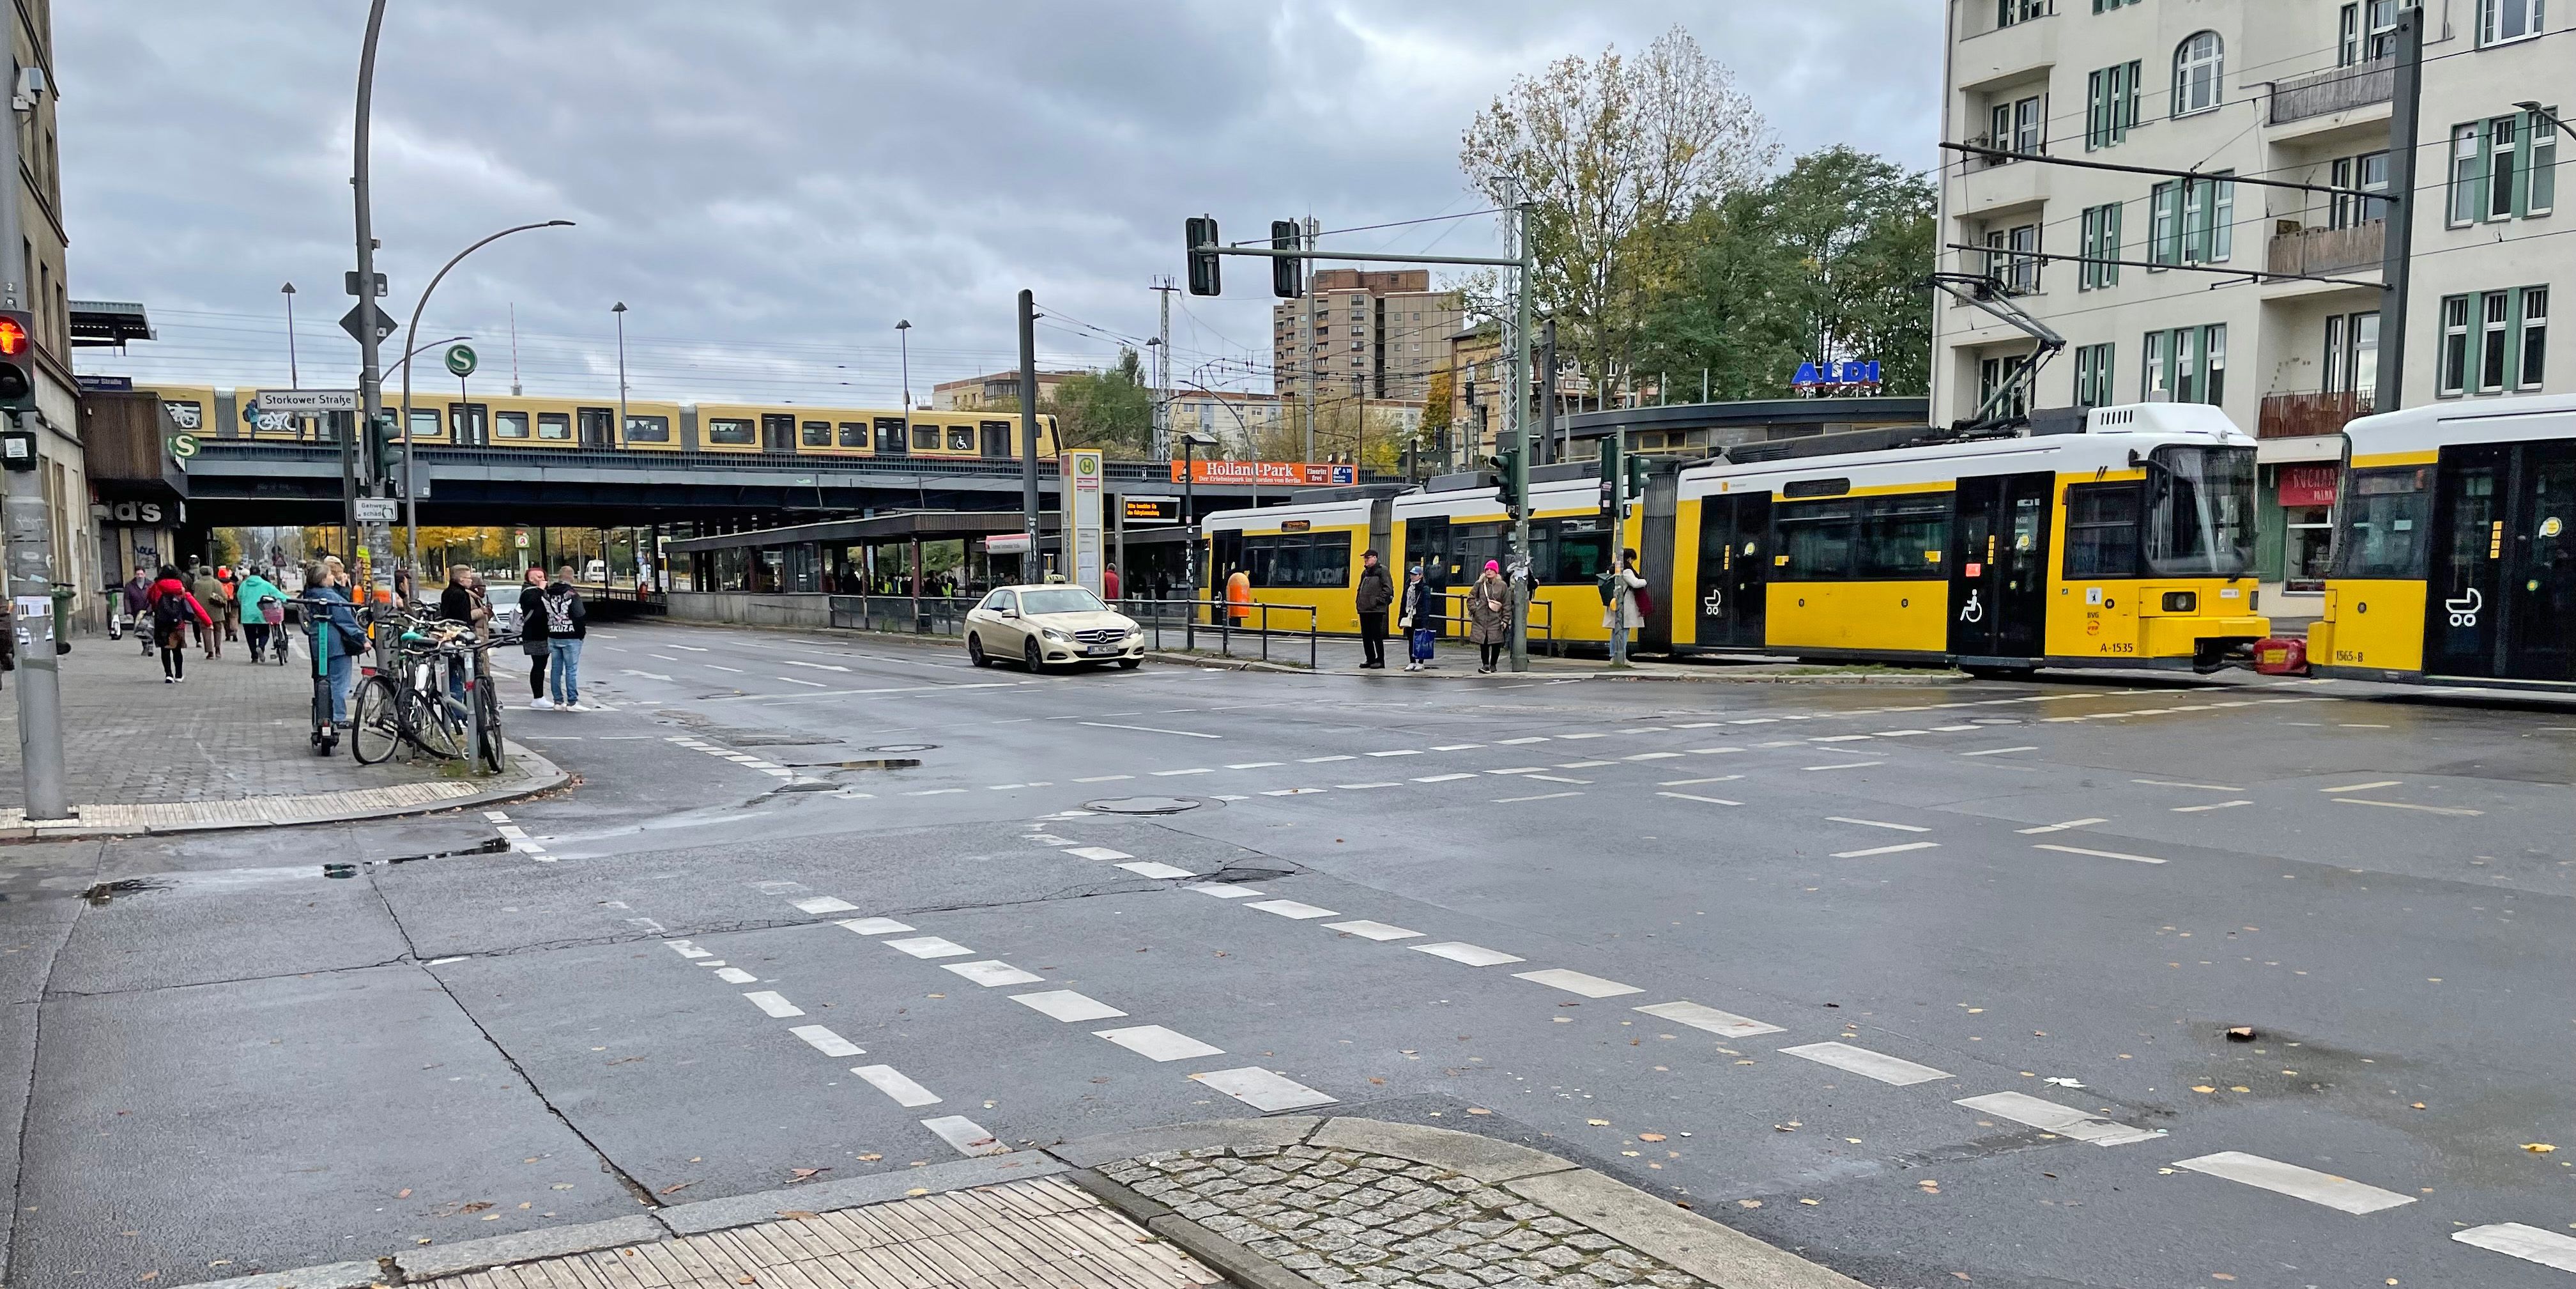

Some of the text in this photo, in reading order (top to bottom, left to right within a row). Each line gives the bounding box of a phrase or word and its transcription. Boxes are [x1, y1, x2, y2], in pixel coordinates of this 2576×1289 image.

[8, 283, 13, 291] 2
[452, 348, 470, 369] S
[1791, 360, 1880, 384] ALDI
[266, 394, 351, 406] Storkower Straße
[176, 435, 195, 456] S
[1084, 461, 1091, 471] H
[1206, 462, 1294, 477] Holland-Park
[2100, 643, 2133, 652] A-1535
[2336, 651, 2363, 663] 1565-B
